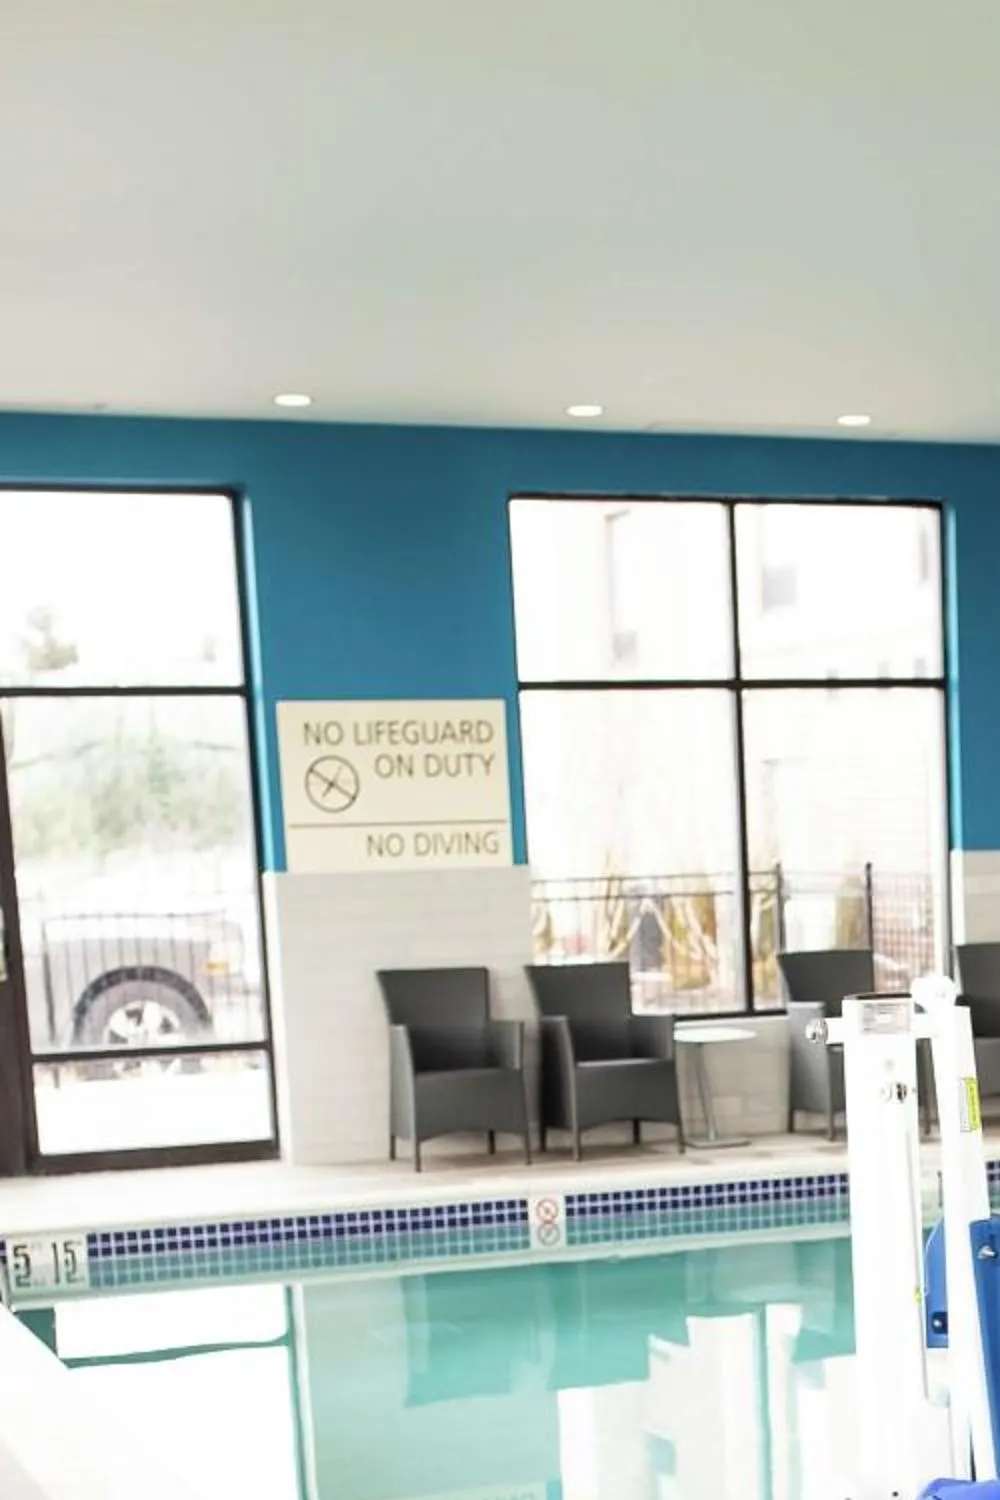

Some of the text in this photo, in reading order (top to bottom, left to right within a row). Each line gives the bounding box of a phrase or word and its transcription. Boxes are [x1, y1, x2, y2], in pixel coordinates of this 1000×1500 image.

[303, 719, 495, 746] NO LIFEGUARD
[374, 752, 496, 779] ON DUTY
[367, 830, 500, 857] NO DIVING
